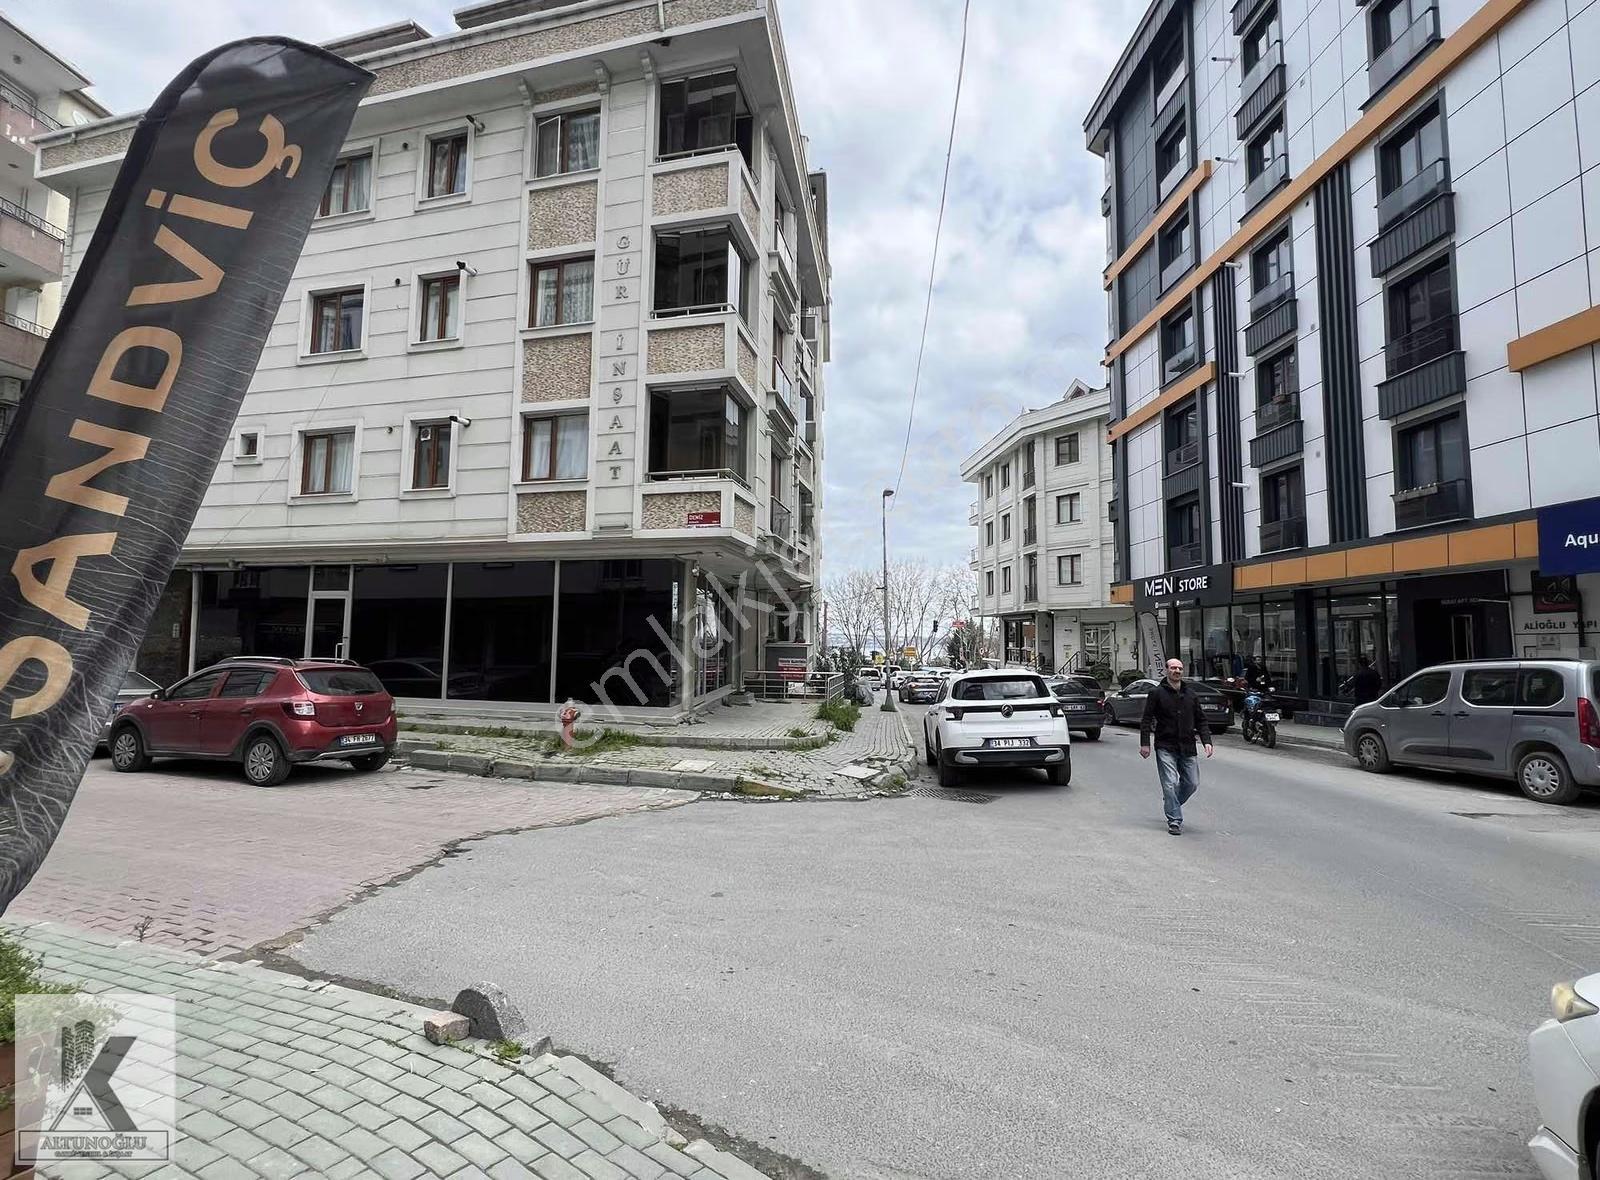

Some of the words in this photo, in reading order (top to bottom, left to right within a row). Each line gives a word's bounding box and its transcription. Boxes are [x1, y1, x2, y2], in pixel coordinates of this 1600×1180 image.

[608, 333, 627, 480] İNŞAAT
[1564, 533, 1600, 548] Aqu
[1144, 576, 1173, 597] MEN
[1178, 576, 1208, 593] STORE
[1524, 620, 1566, 630] ALİOĞLU
